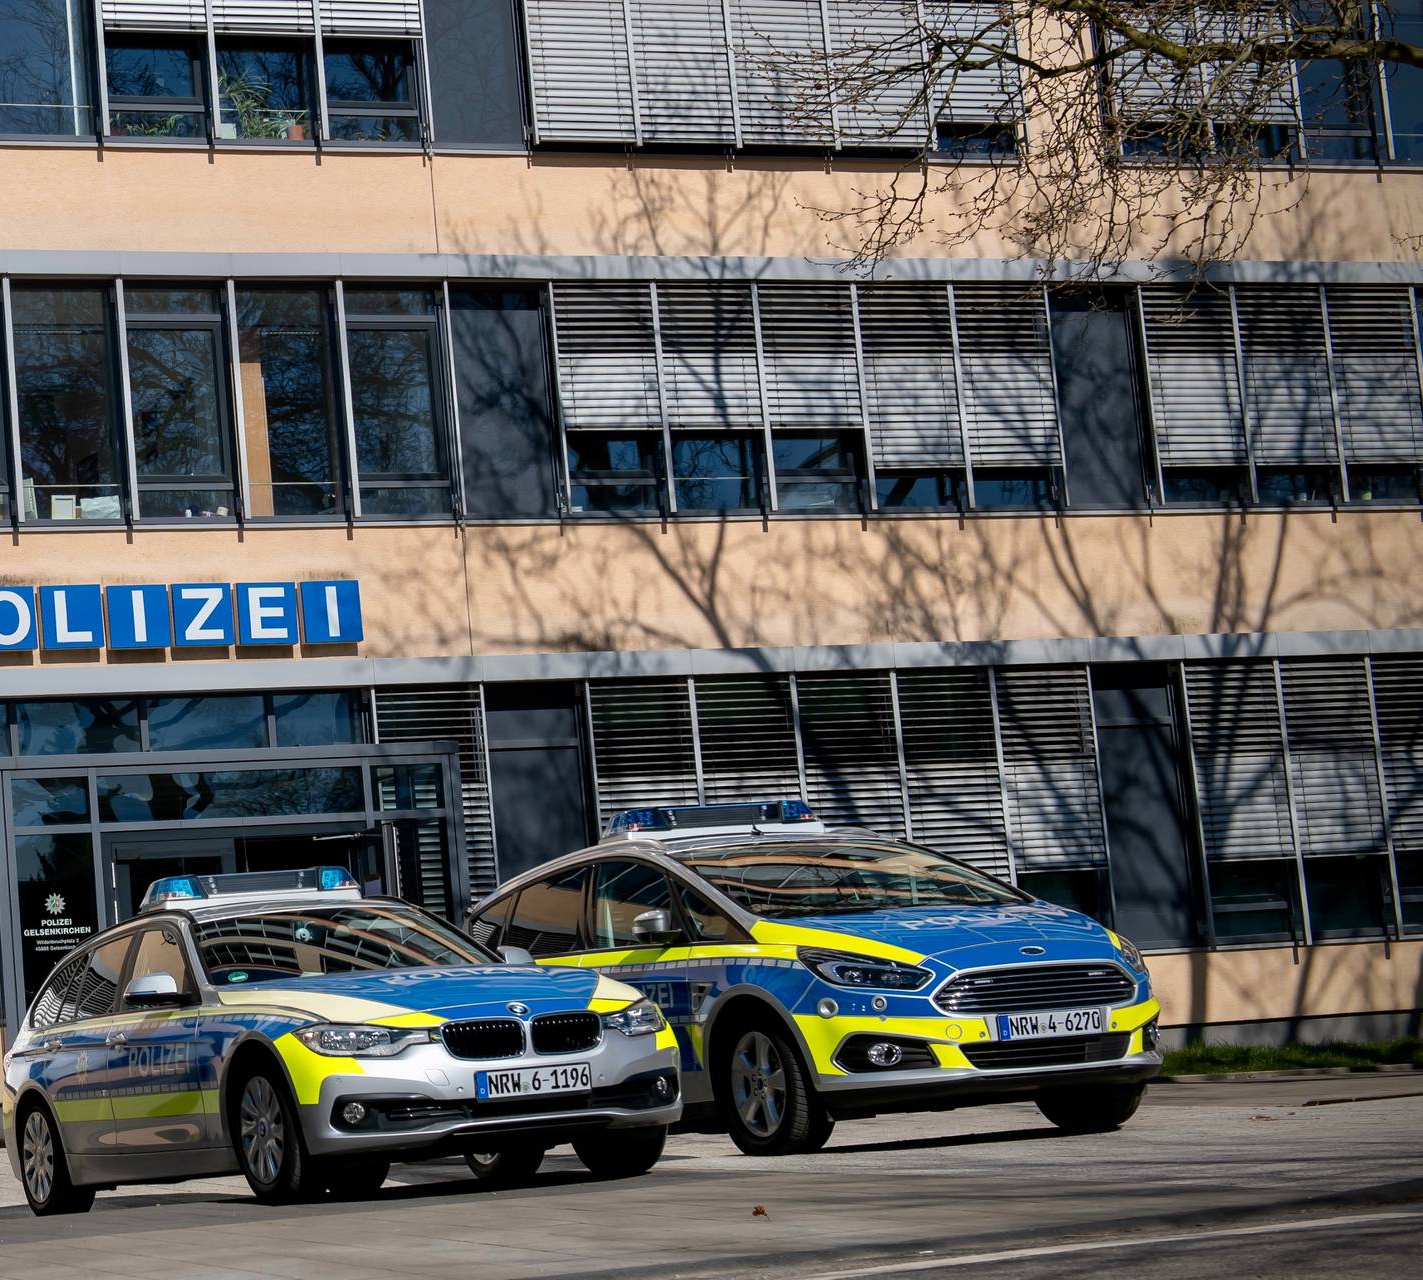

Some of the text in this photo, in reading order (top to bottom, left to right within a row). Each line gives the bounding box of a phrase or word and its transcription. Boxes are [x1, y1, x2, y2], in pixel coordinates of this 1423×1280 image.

[23, 926, 92, 937] GELSENKIRCHEN
[41, 918, 73, 927] POLIZEI
[1010, 1016, 1039, 1036] NRW
[1048, 1011, 1100, 1033] 4-6270
[129, 1041, 190, 1078] POLIZEI
[488, 1073, 521, 1095] NRW
[532, 1067, 589, 1090] 6-1196
